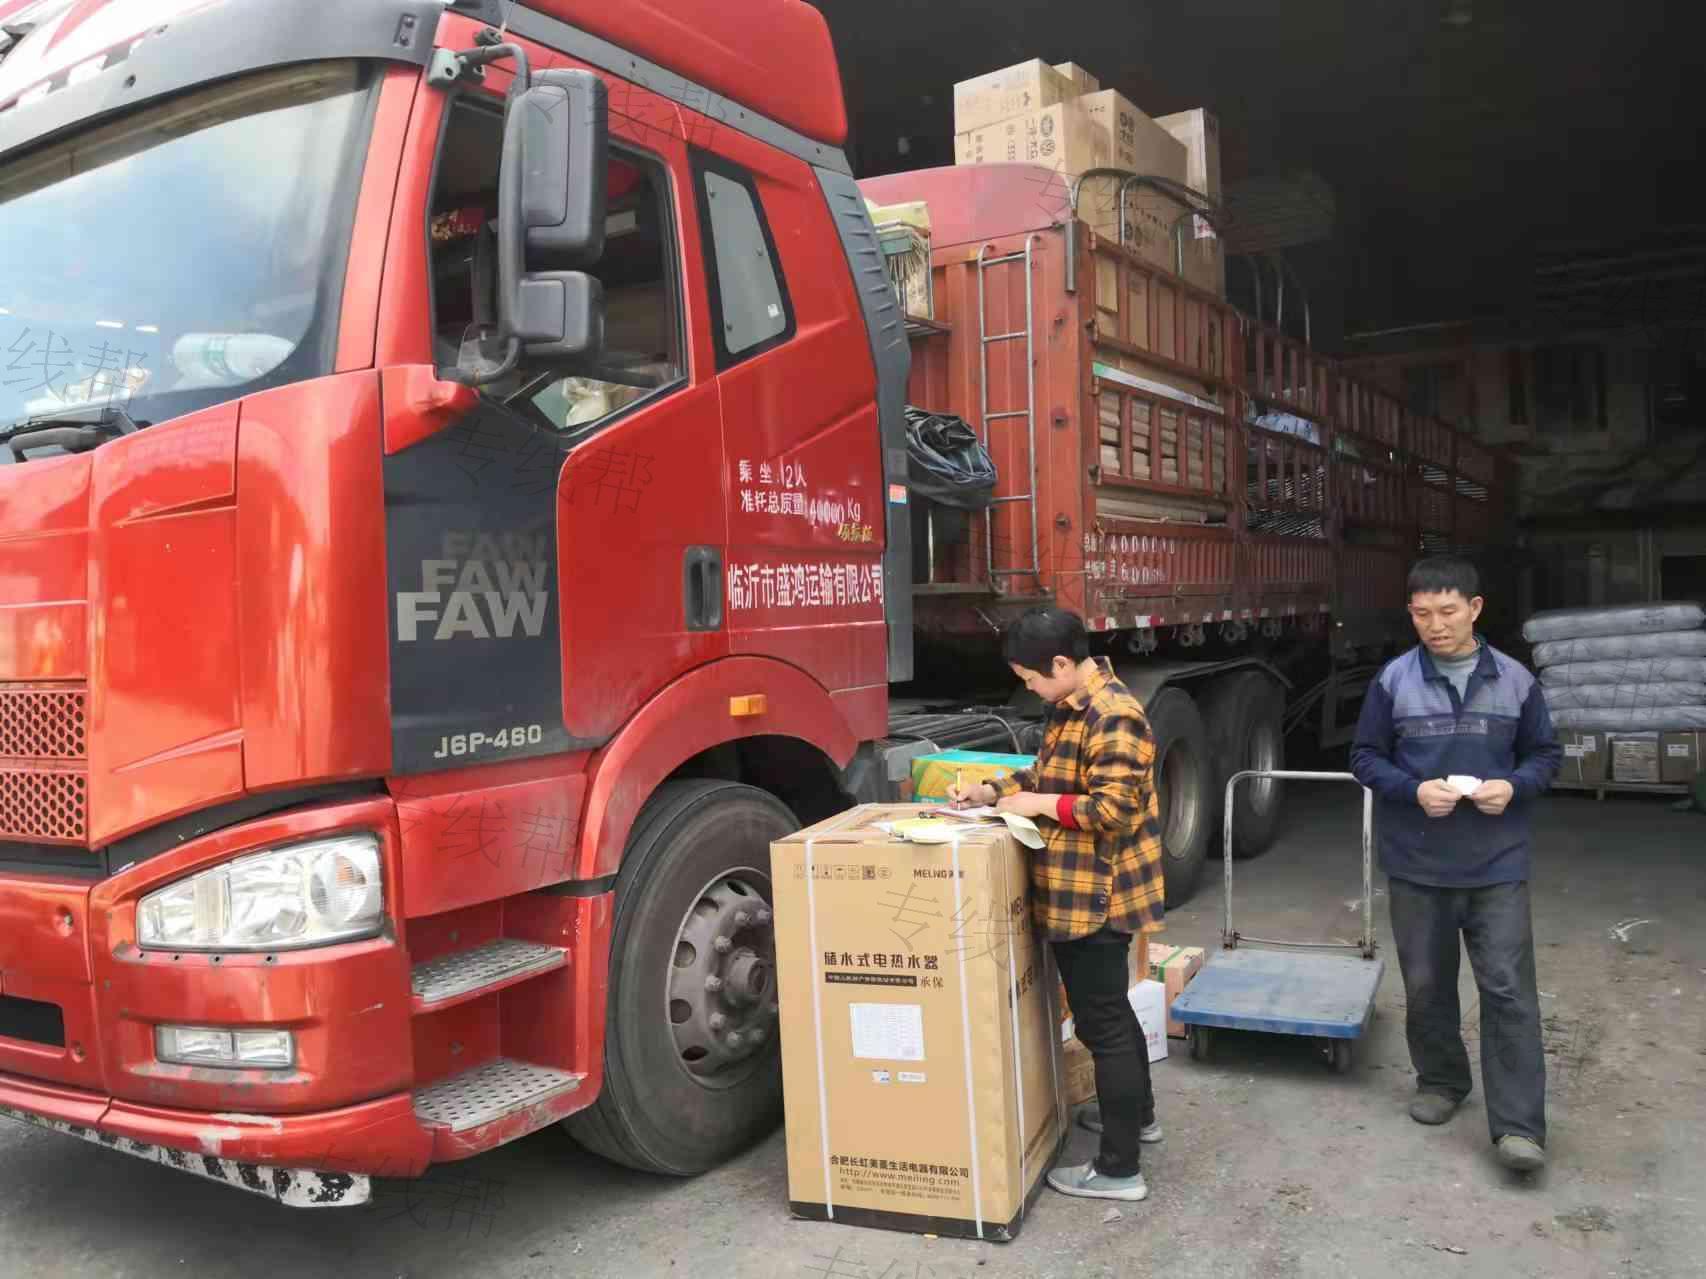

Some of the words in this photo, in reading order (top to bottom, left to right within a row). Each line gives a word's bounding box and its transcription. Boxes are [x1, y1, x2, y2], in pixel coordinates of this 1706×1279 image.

[421, 560, 547, 592] FAW
[728, 563, 883, 609] 临沂市盛鸿运输有限公司
[396, 591, 548, 641] FAW
[433, 724, 542, 759] J6P-460
